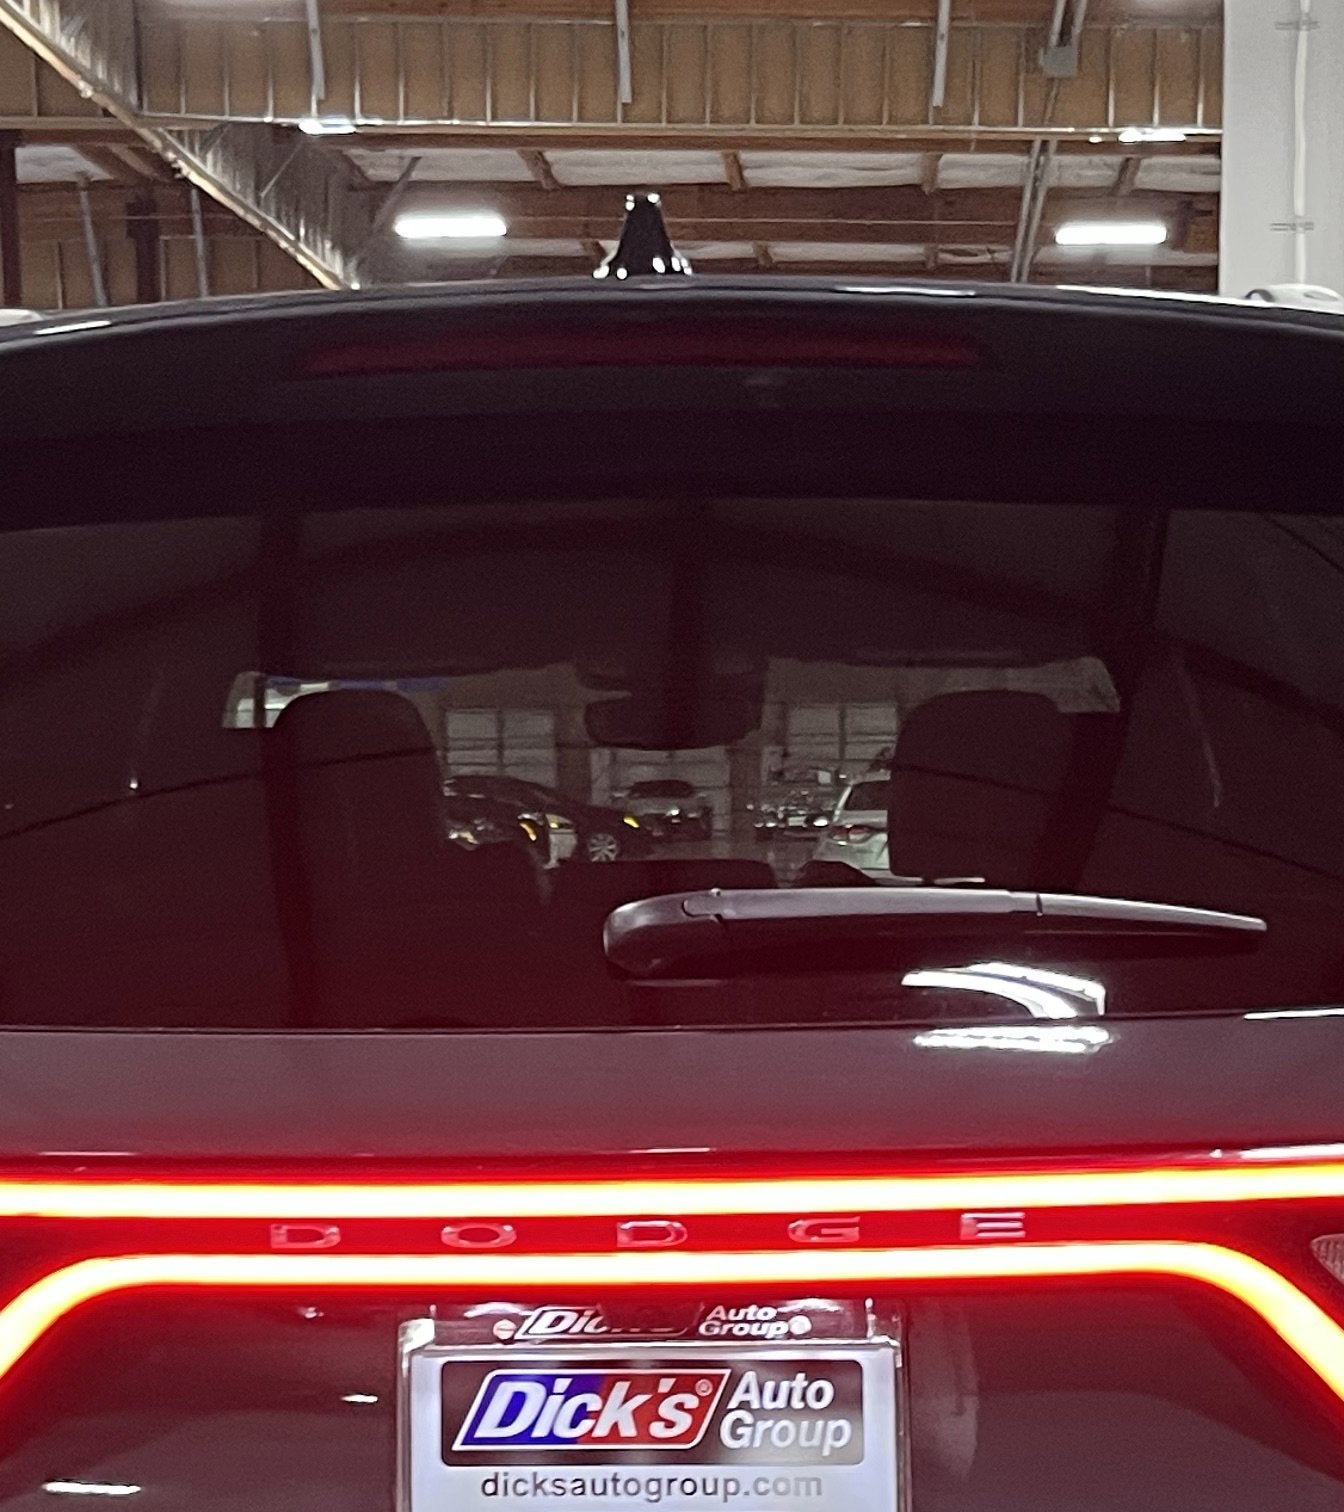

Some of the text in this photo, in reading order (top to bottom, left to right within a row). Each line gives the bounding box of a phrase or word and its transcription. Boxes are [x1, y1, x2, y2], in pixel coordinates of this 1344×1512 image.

[270, 1211, 1026, 1249] DODGE
[699, 1320, 789, 1339] Group
[707, 1305, 777, 1321] Auto
[473, 1376, 700, 1440] Dick's
[728, 1370, 834, 1411] Auto
[719, 1411, 852, 1456] Group
[481, 1471, 823, 1503] dicksautogroup.com
